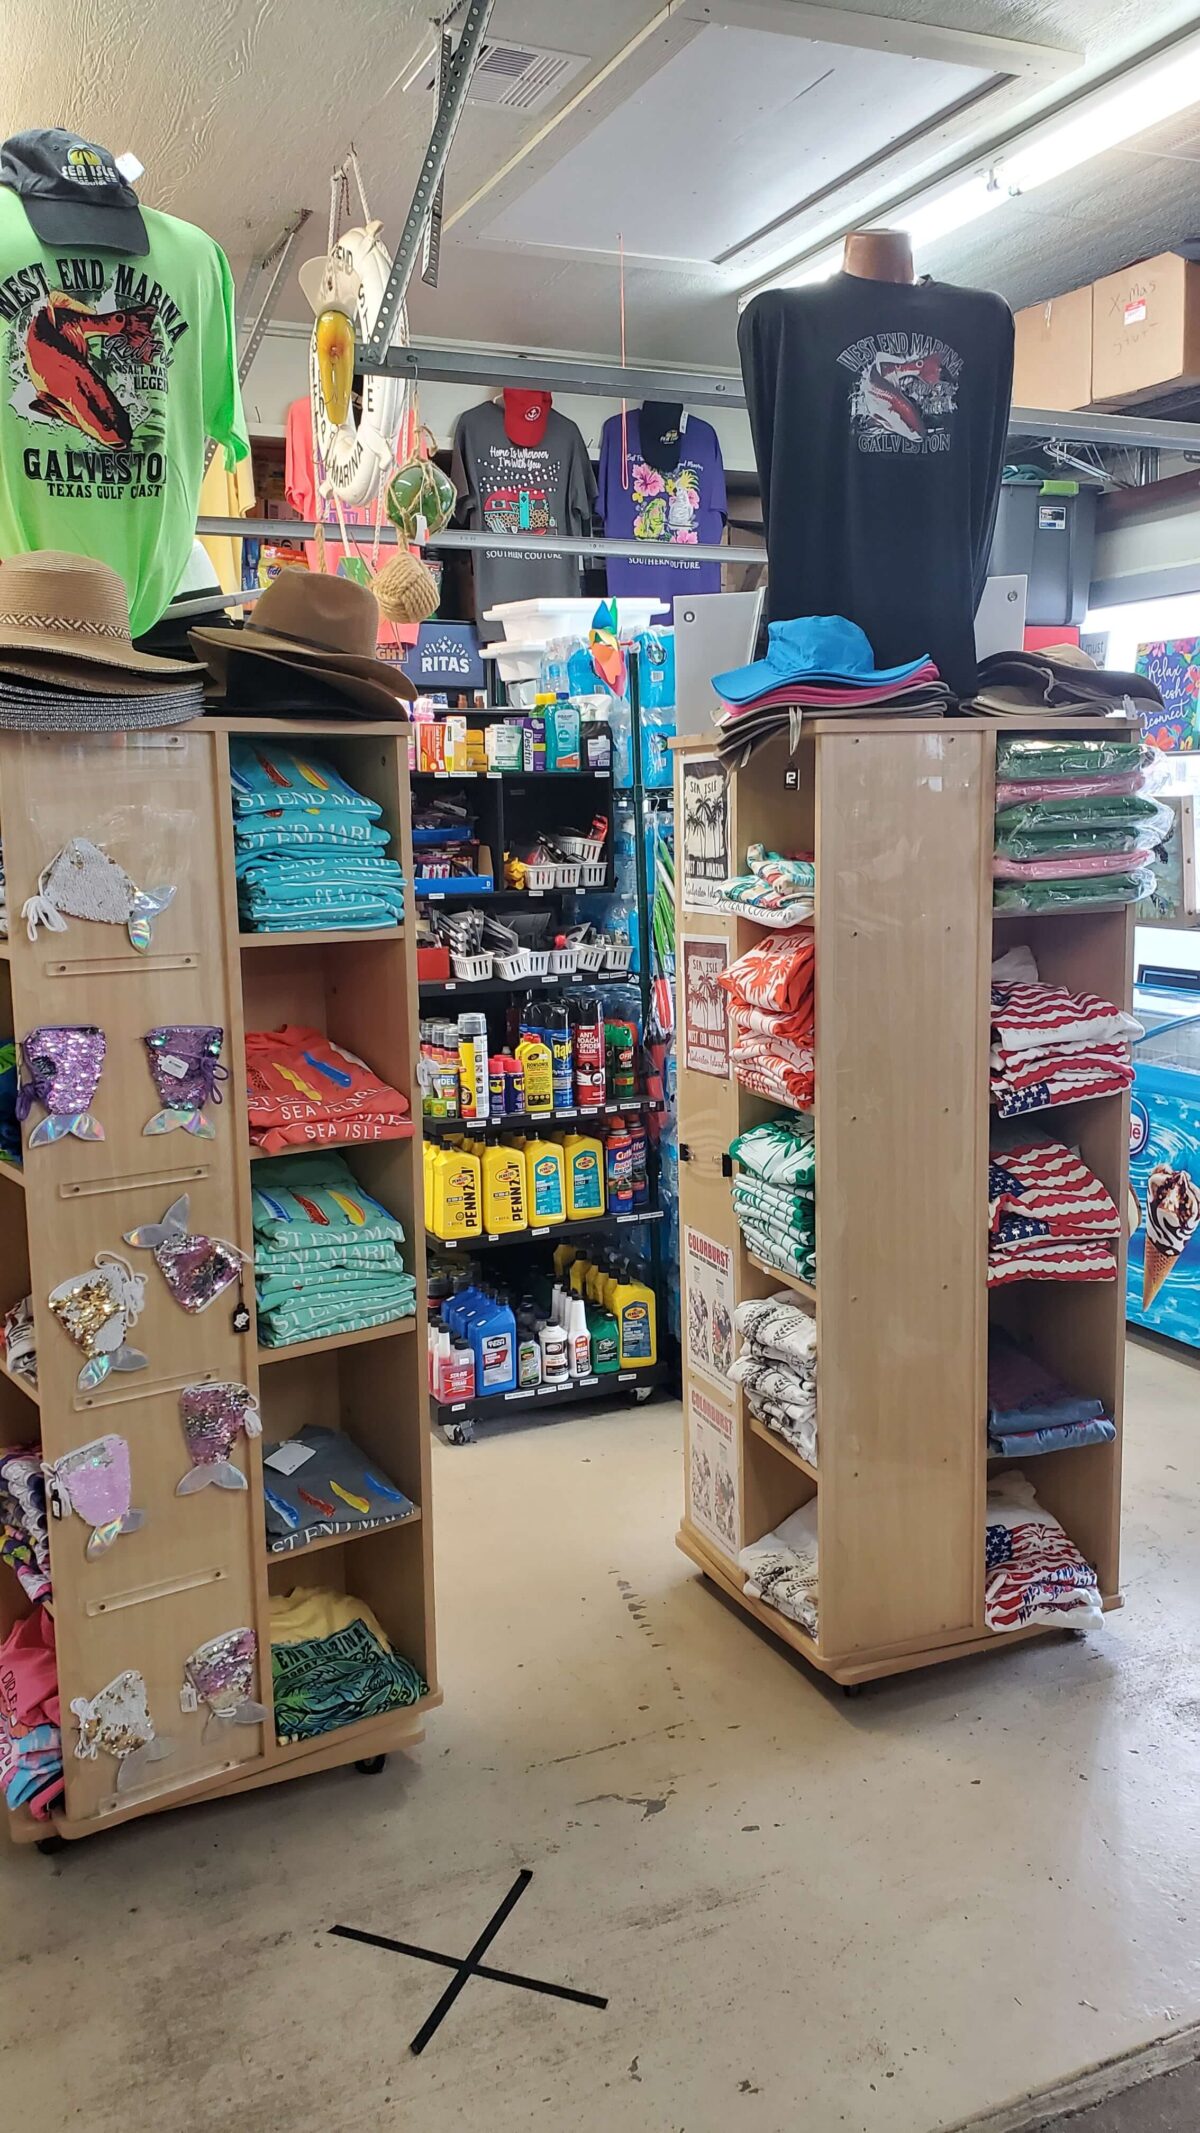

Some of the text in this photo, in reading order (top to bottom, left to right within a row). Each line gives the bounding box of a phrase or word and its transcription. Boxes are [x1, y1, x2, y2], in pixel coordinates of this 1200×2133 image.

[61, 165, 116, 178] SEA ISLE
[0, 258, 189, 346] WEST END MARINA
[104, 332, 144, 362] Red
[836, 332, 964, 376] WEST END MARINA
[122, 364, 145, 375] SALT
[489, 446, 510, 458] Home
[858, 433, 951, 454] GALVESTON
[331, 439, 364, 489] MARINA
[47, 482, 92, 499] TEXAS
[96, 485, 124, 500] GULF
[421, 655, 471, 674] RITAS
[1149, 656, 1183, 687] Relax
[524, 731, 533, 765] Desitin
[690, 781, 718, 795] SEA ISLE
[276, 791, 326, 805] END
[280, 1105, 317, 1120] SEA
[304, 1123, 382, 1139] SEA ISLE
[310, 1230, 359, 1247] END
[688, 1232, 729, 1270] COLORBURST
[275, 1648, 308, 1671] END
